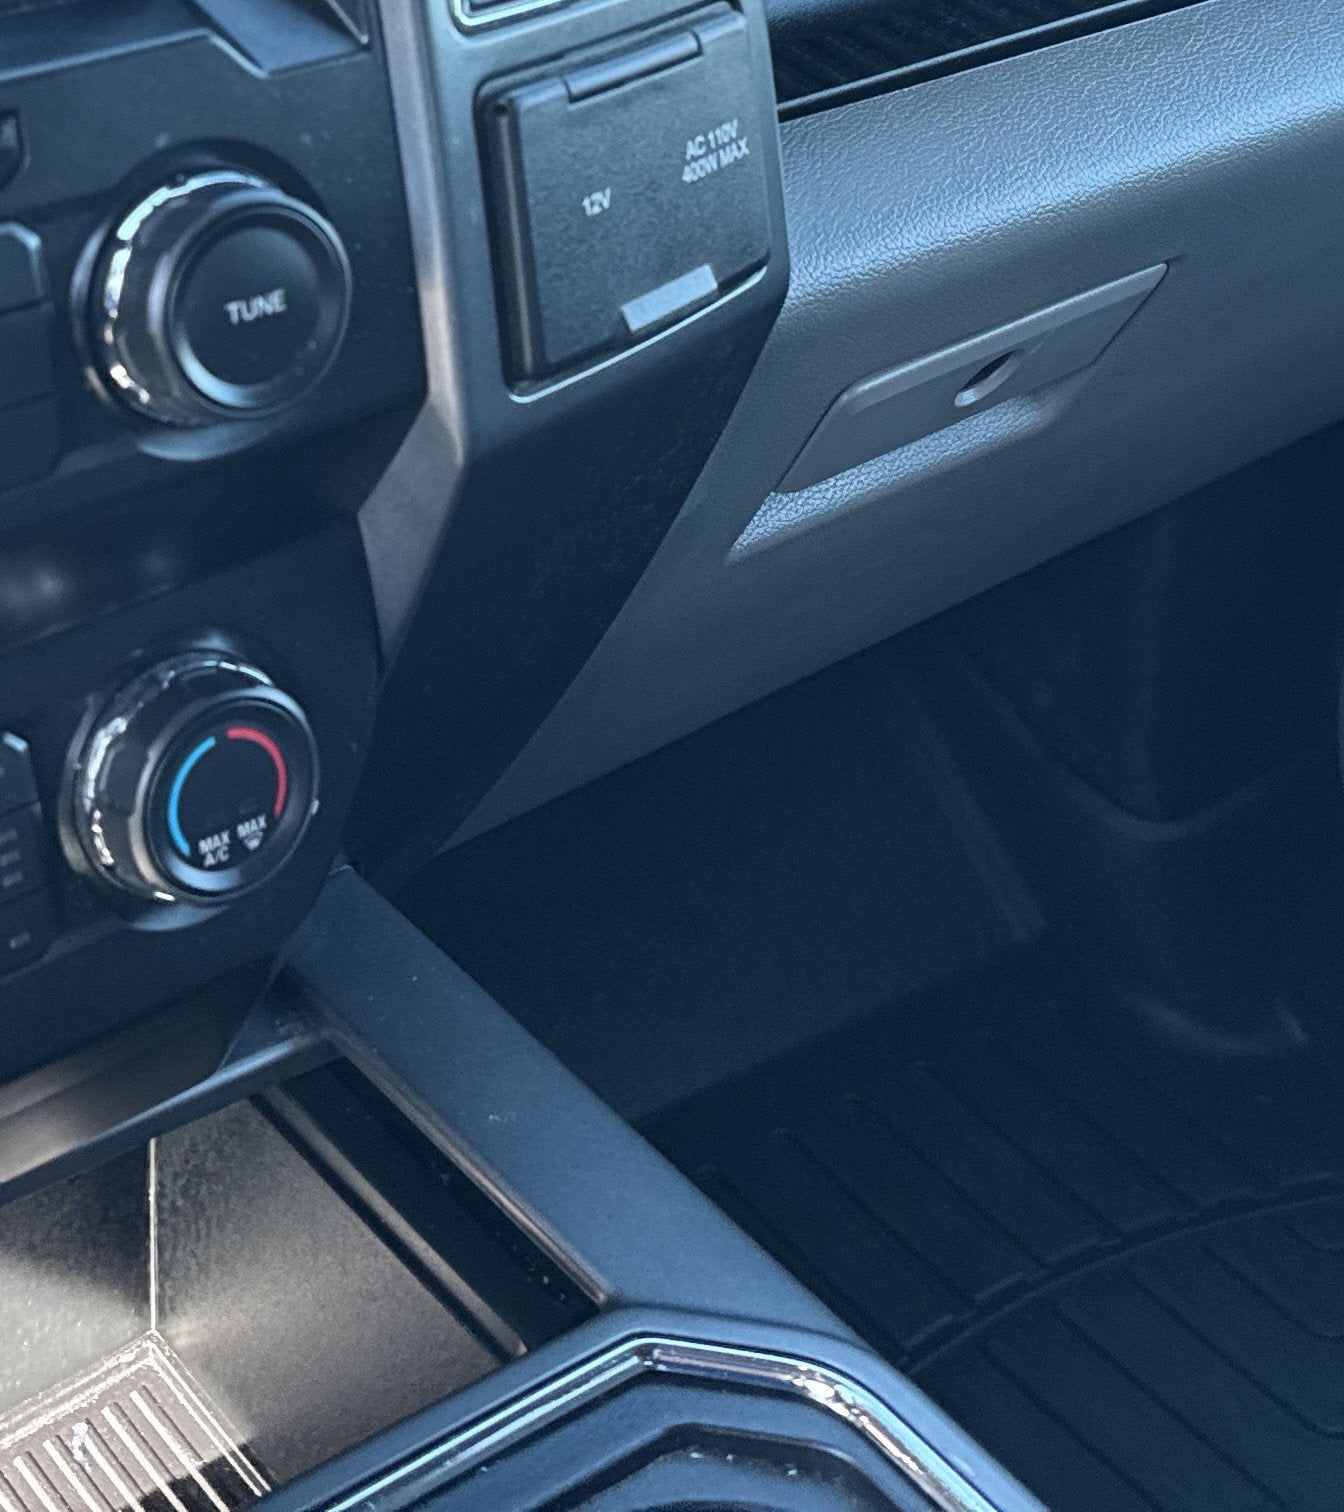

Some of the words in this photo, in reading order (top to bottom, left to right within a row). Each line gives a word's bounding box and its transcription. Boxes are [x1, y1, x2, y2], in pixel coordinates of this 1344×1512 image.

[718, 136, 751, 169] MAX
[582, 187, 612, 217] 12V
[223, 287, 288, 325] TUNE
[237, 814, 267, 839] MAX
[198, 830, 230, 855] MAX
